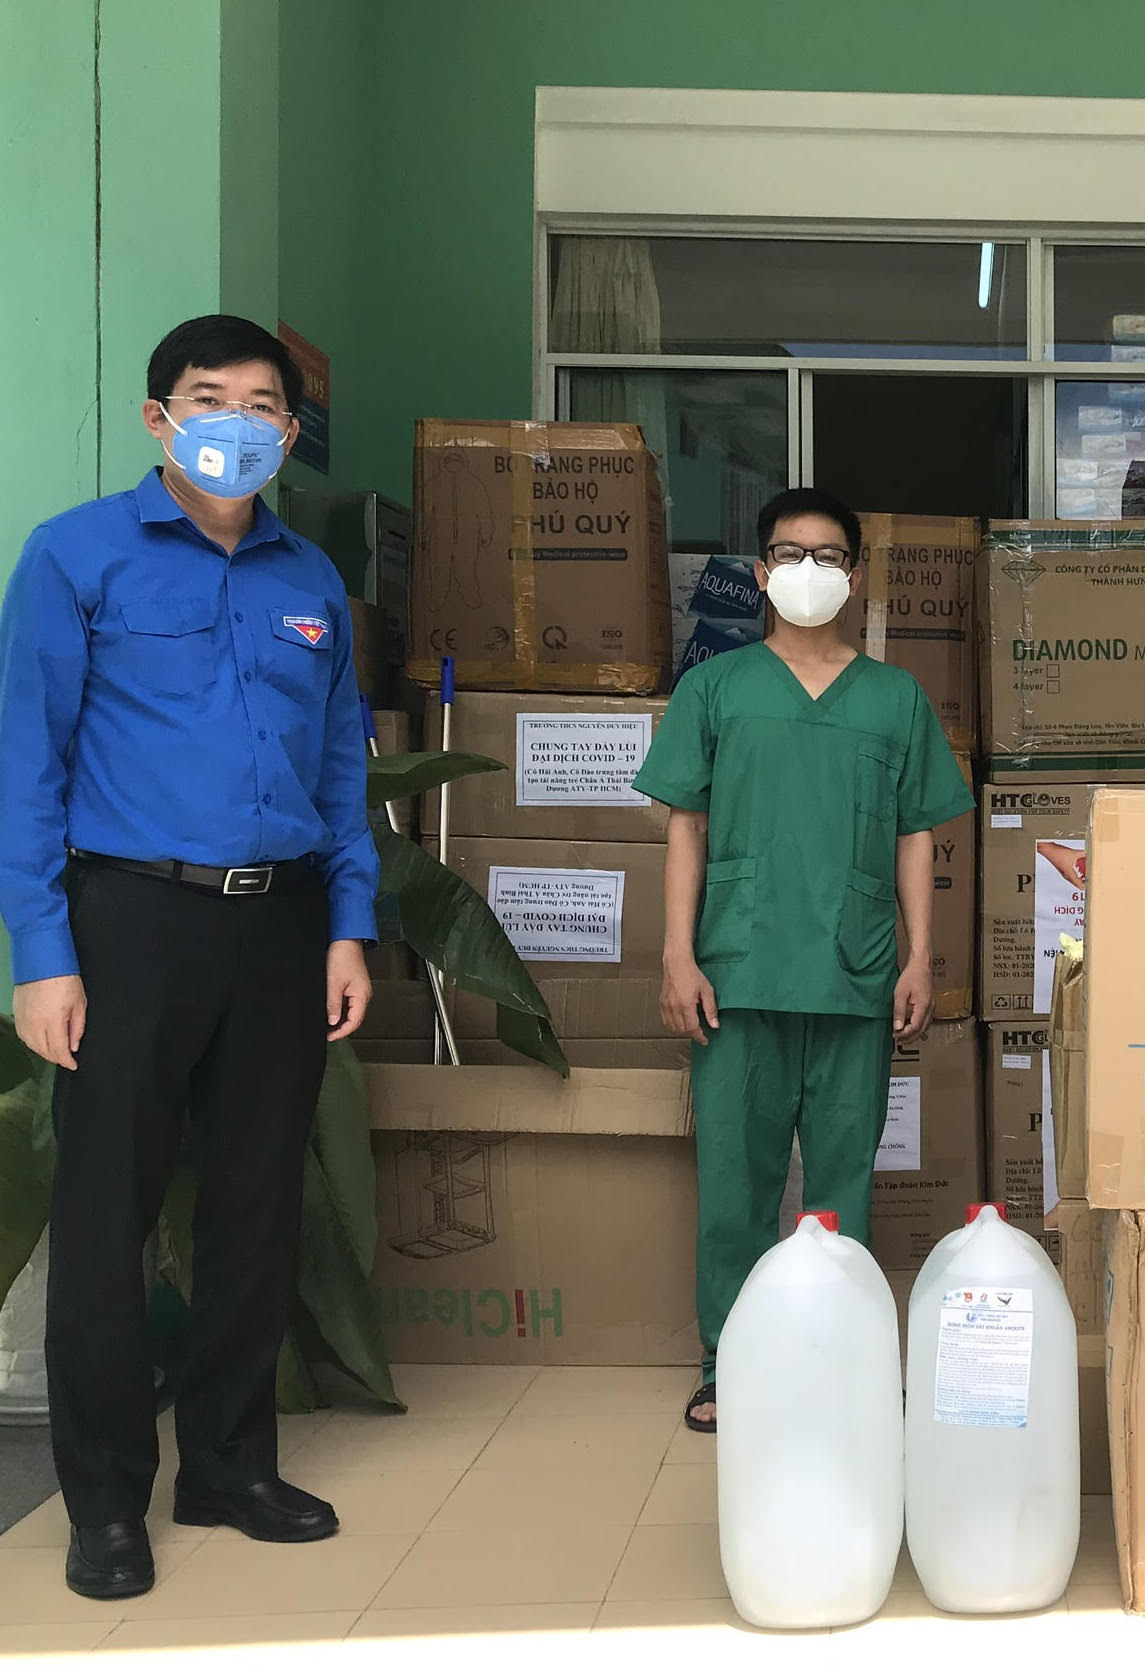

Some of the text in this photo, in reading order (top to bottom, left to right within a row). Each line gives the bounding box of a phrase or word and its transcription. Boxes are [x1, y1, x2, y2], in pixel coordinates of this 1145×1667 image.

[589, 457, 634, 477] PHỤC
[575, 510, 630, 534] QUÝ
[888, 548, 973, 569] RANG PHỤC
[699, 572, 760, 609] AQUAFINA
[921, 597, 969, 618] QUÝ
[1012, 638, 1128, 661] DIAMOND
[531, 743, 568, 751] CHUNG
[571, 743, 592, 751] TAY
[532, 755, 550, 763] ĐẠI
[554, 755, 579, 763] DỊCH
[992, 794, 1033, 807] HTC
[503, 912, 512, 920] 19
[523, 912, 556, 920] COVID
